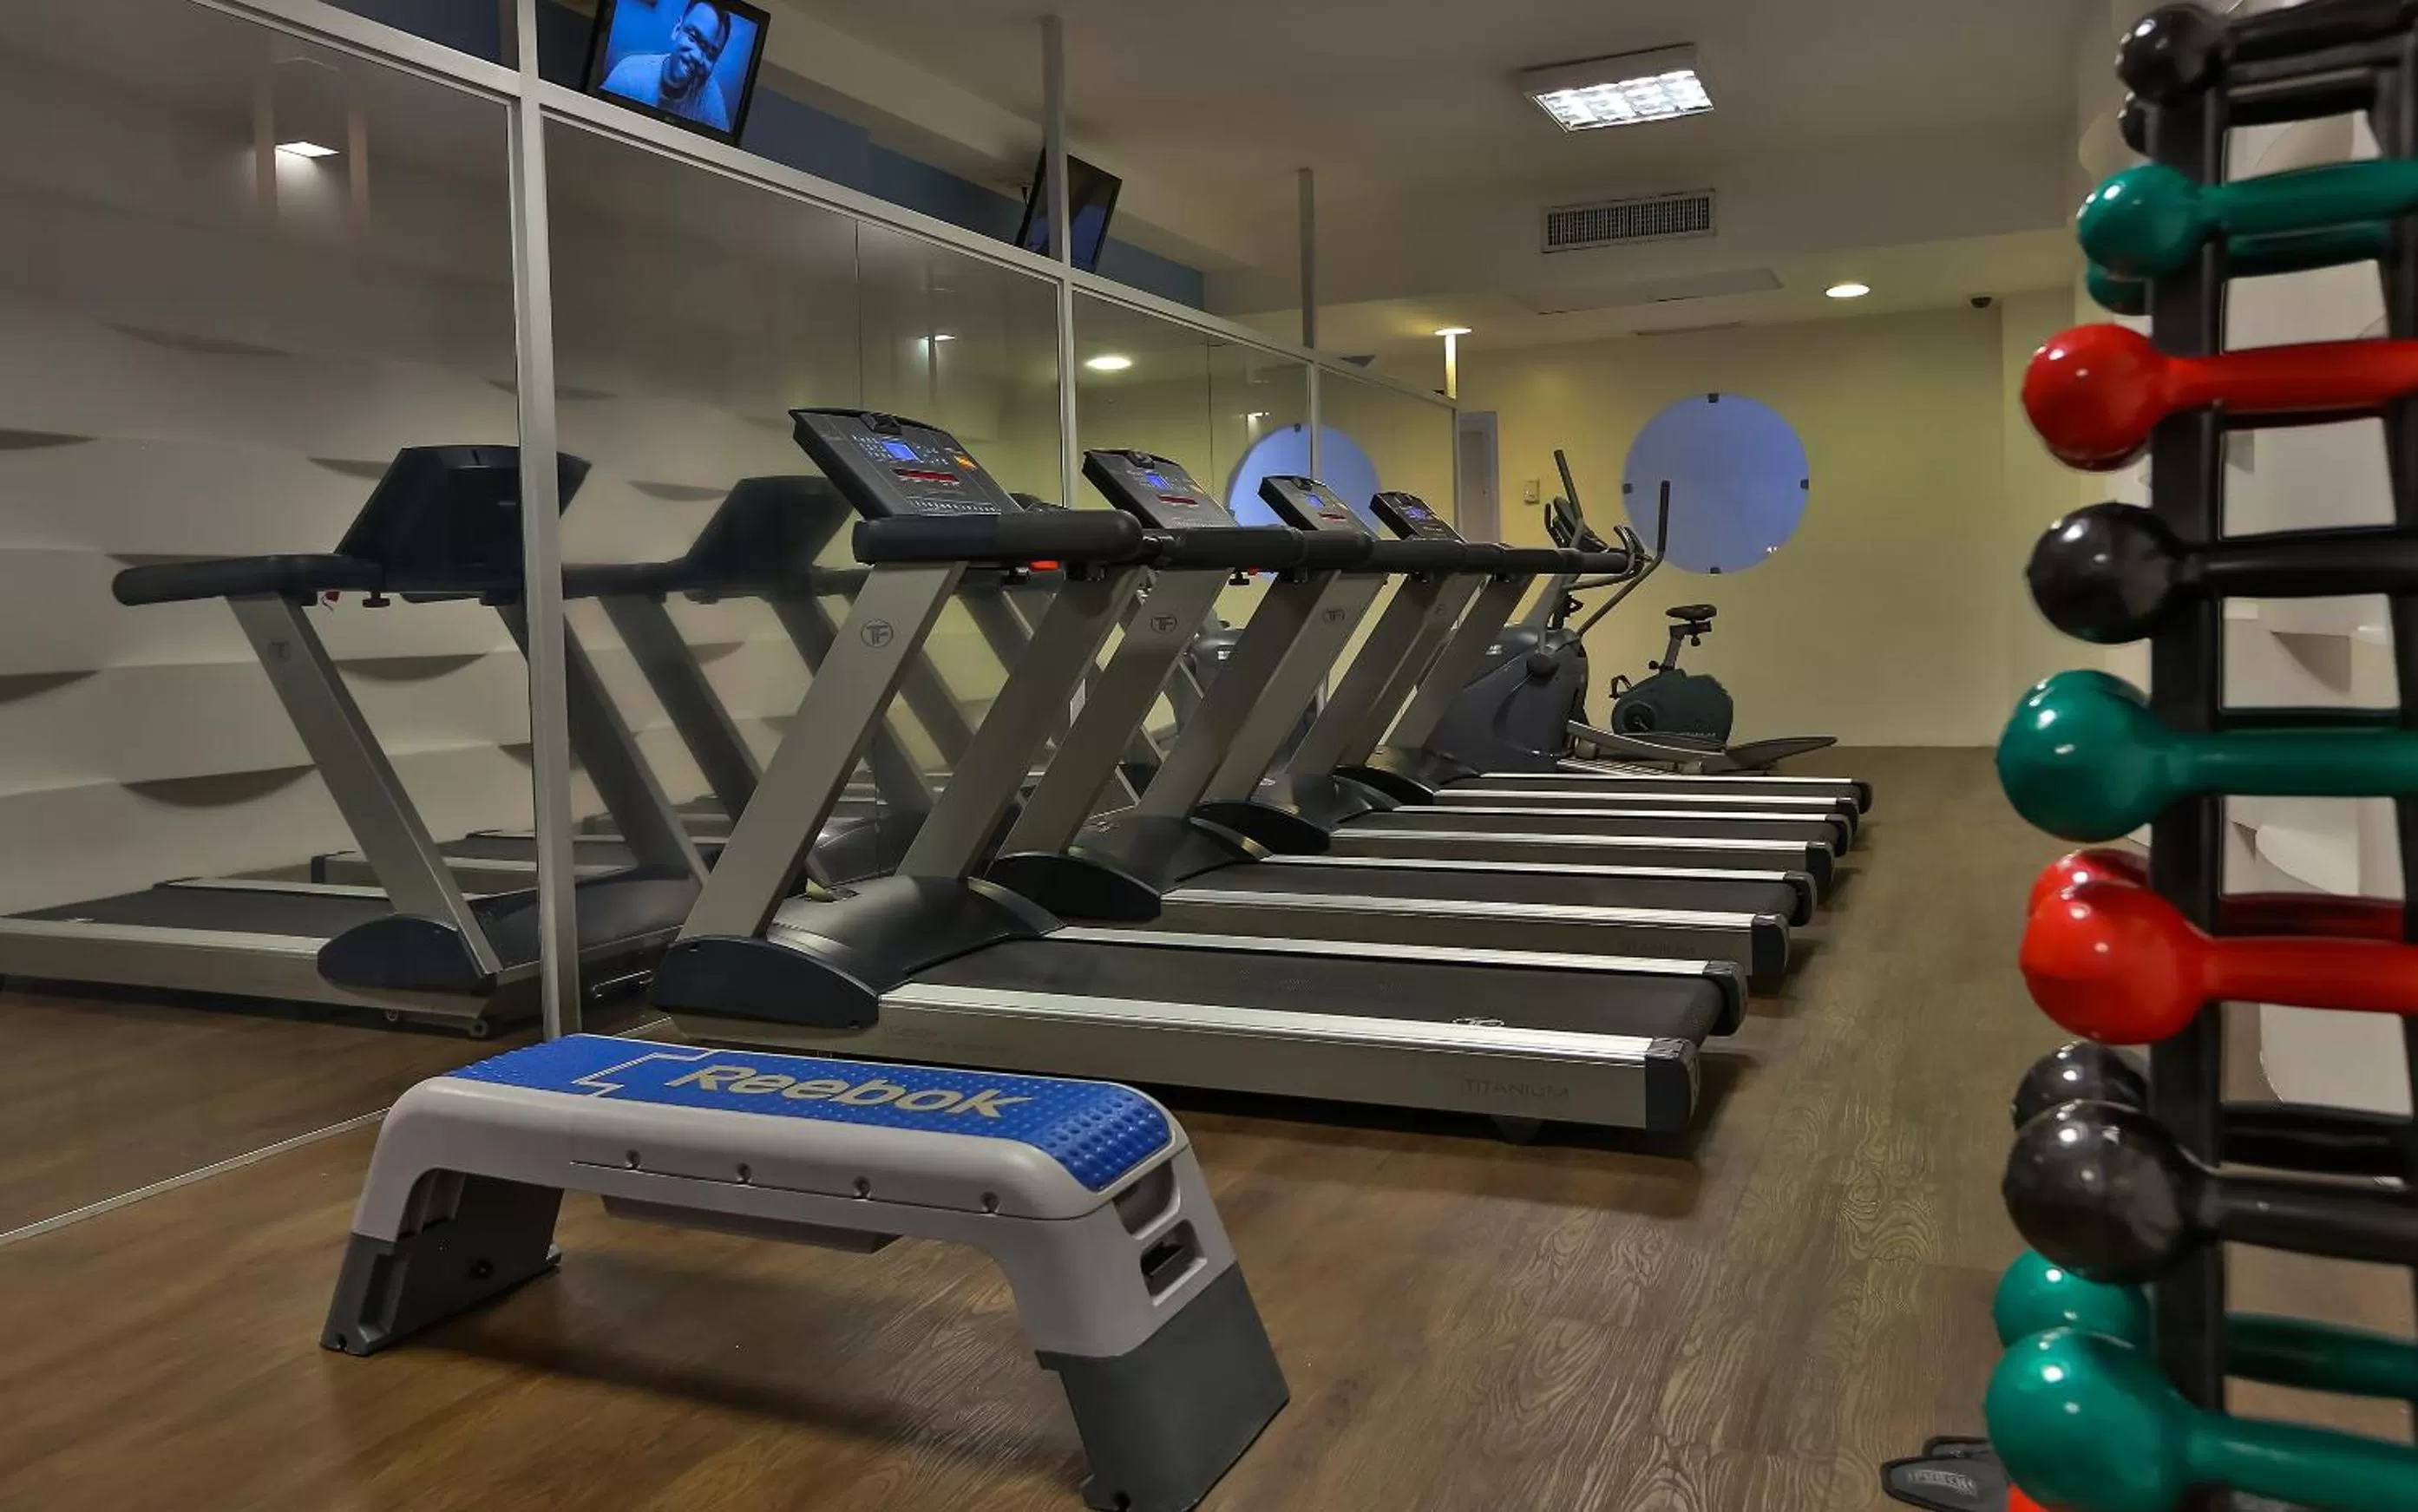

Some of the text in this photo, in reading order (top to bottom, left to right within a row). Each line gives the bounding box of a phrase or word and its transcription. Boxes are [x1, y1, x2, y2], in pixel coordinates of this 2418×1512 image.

[864, 622, 890, 646] TF
[664, 1064, 1032, 1118] Reebok
[1465, 1078, 1569, 1097] TITANIUM
